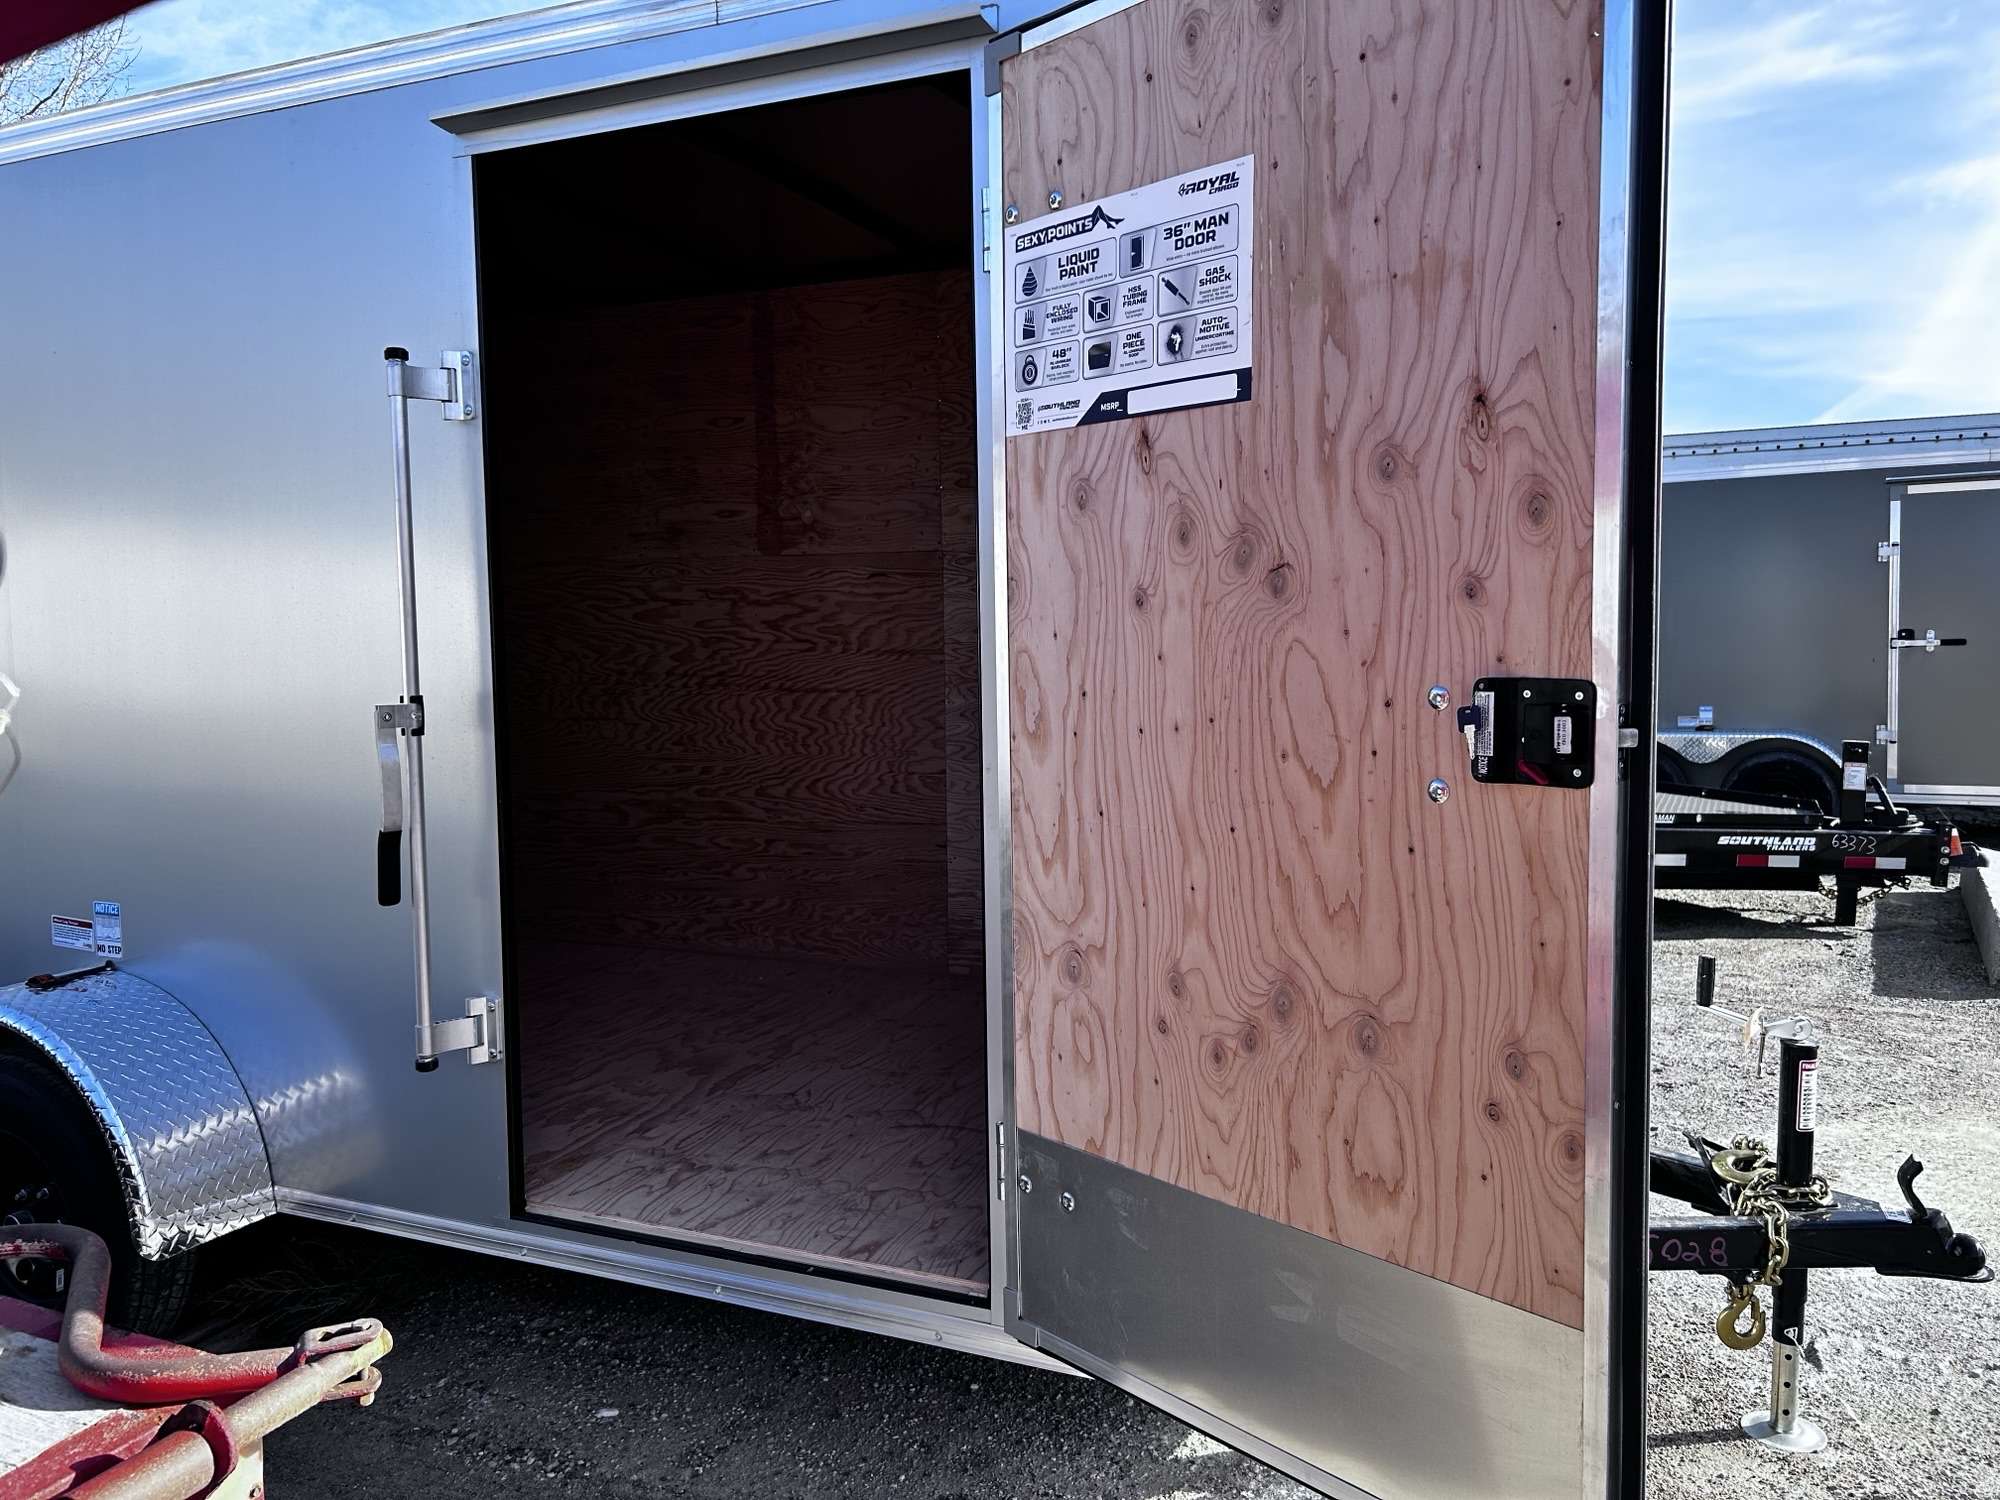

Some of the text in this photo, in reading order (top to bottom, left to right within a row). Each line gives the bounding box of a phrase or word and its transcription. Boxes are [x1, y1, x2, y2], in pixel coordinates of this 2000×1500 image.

[1185, 171, 1240, 195] ROYAL
[1209, 182, 1239, 195] CARGO
[1194, 212, 1229, 232] MAN
[1174, 229, 1216, 251] DOOR
[1058, 248, 1100, 268] LIQUID
[1060, 261, 1098, 280] PAINT
[1205, 265, 1225, 277] GAS
[1199, 272, 1231, 287] SHOCK
[1128, 285, 1142, 293] HSS
[1123, 290, 1148, 301] TUBING
[1053, 302, 1071, 311] FULLY
[1122, 297, 1147, 308] FRAME
[1046, 306, 1078, 319] ENCLOSED
[1051, 314, 1073, 324] WIRING
[1201, 316, 1228, 327] AUTO-
[1199, 322, 1230, 334] MOTIVE
[1126, 331, 1142, 341] ONE
[1122, 338, 1145, 350] PIECE
[1478, 756, 1488, 775] NOTICE
[1717, 836, 1816, 845] SOUTHLAND
[1832, 833, 1876, 854] 63373
[95, 904, 118, 914] NOTICE
[97, 944, 105, 953] NO
[108, 945, 121, 954] STEP
